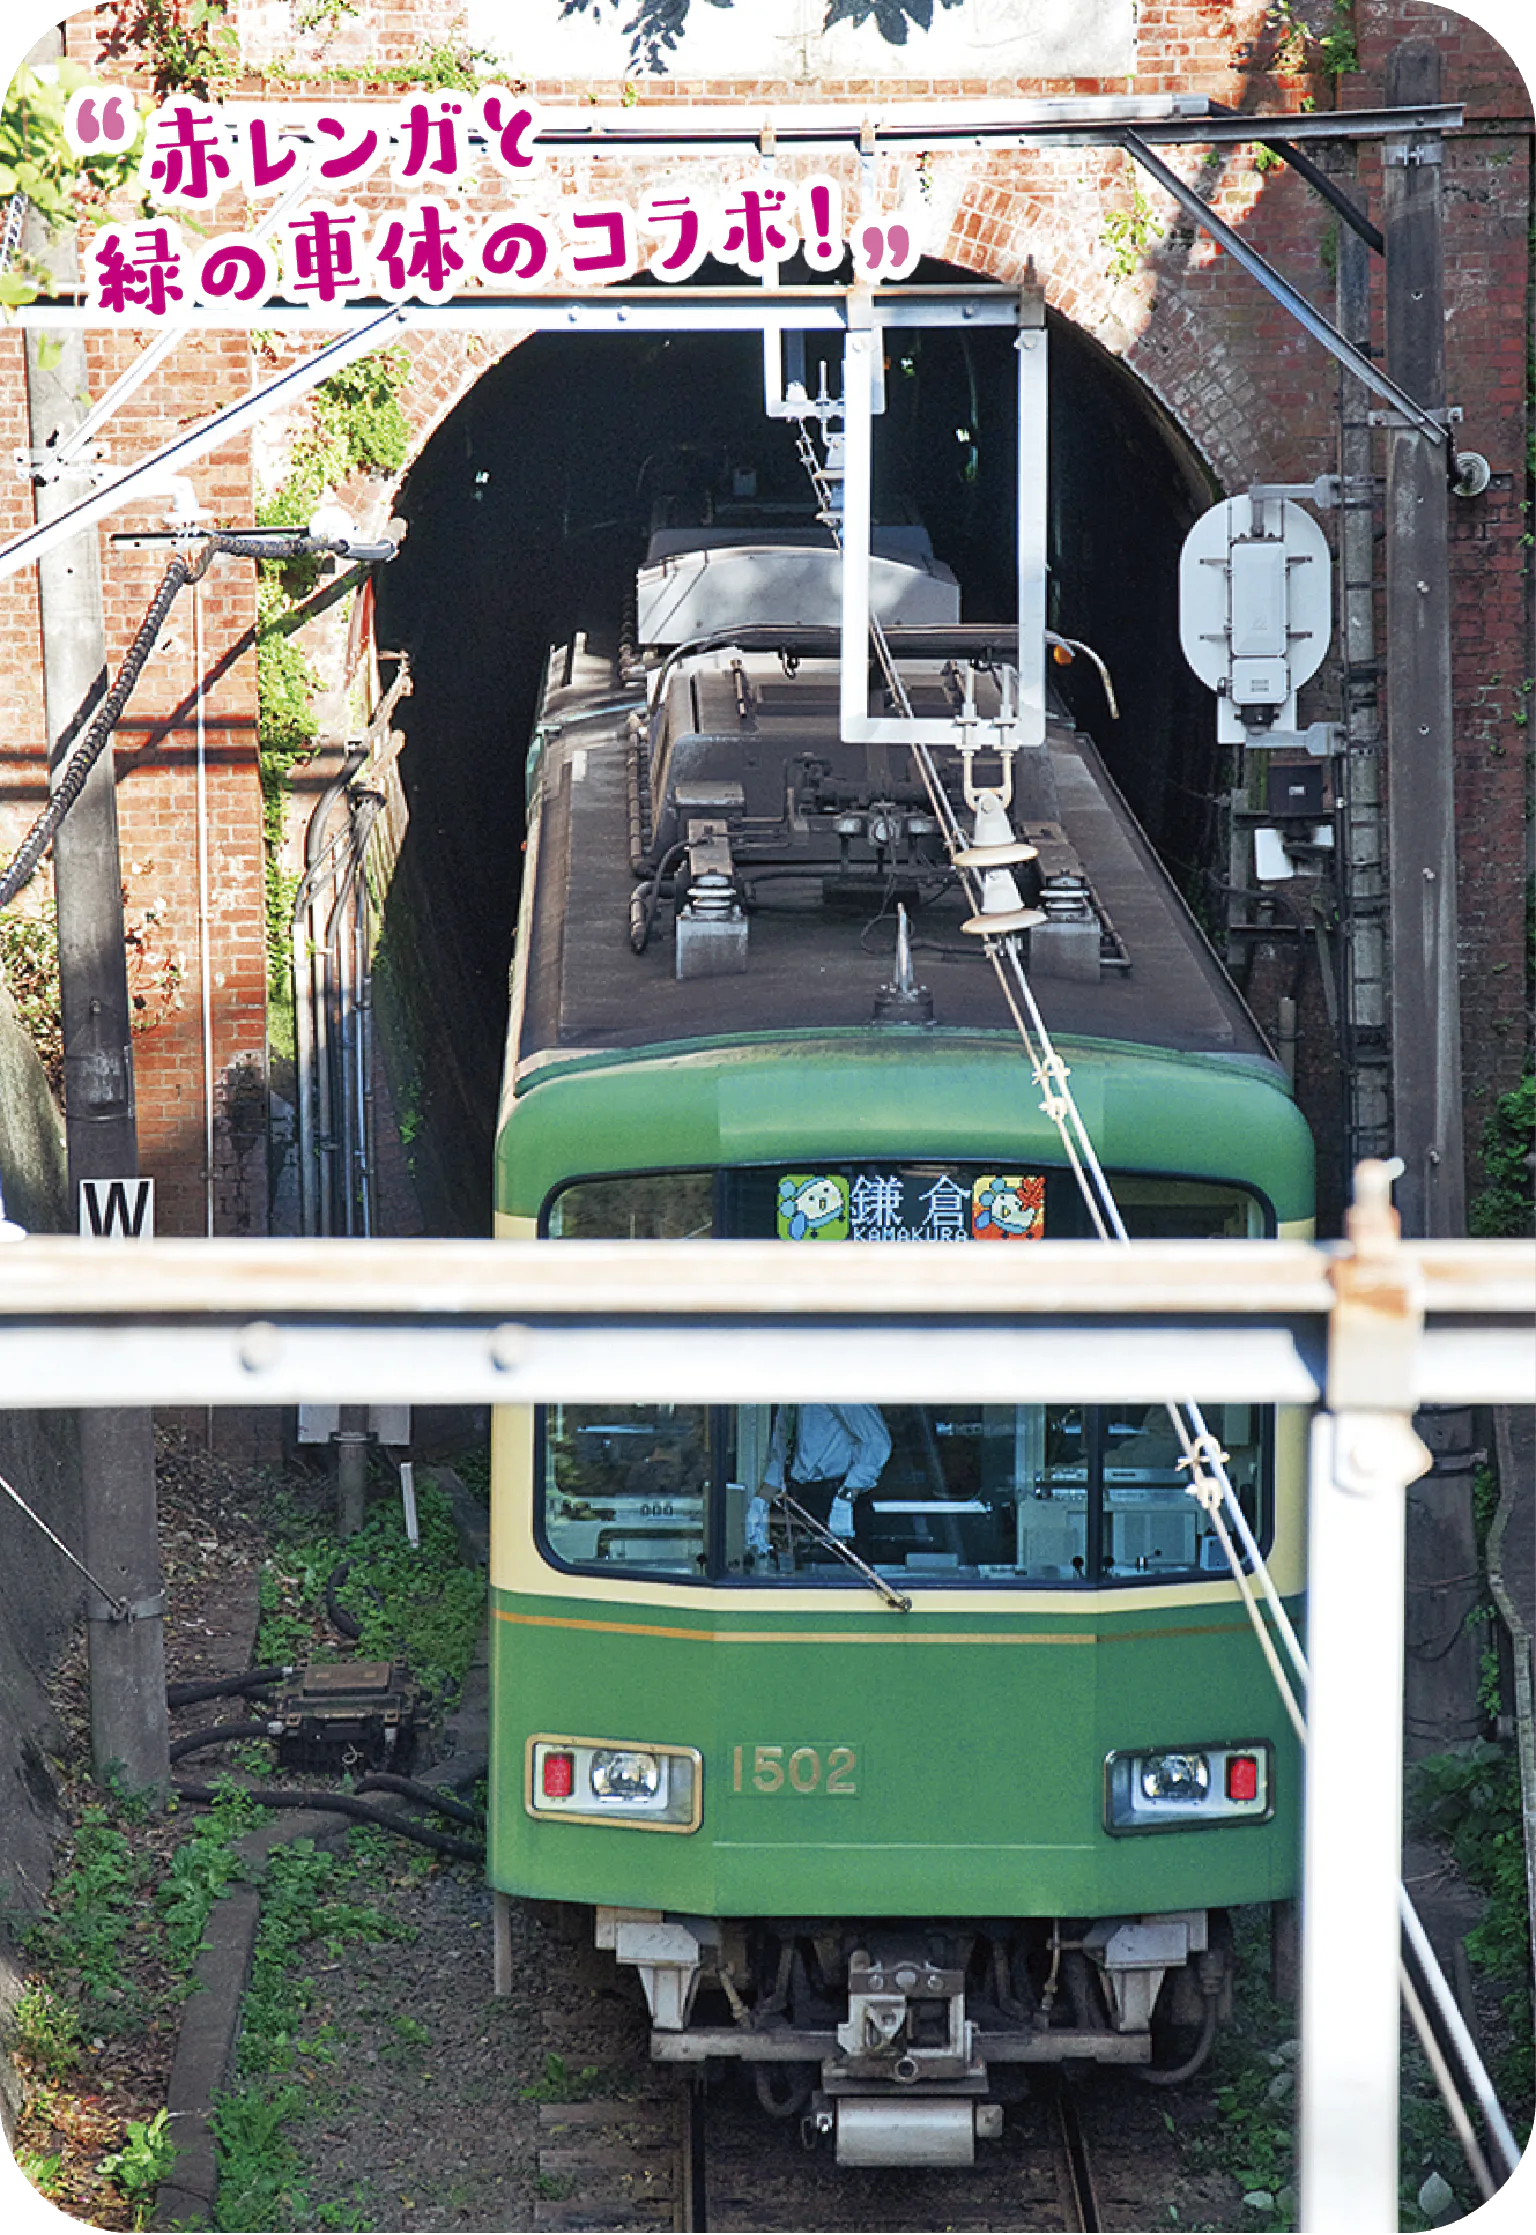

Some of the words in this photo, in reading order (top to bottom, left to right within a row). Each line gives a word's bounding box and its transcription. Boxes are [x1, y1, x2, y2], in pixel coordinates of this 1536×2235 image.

[82, 1181, 150, 1237] W
[849, 1174, 972, 1227] 鎌倉
[853, 1226, 968, 1241] KAMAKURA
[733, 1745, 856, 1794] 1502
